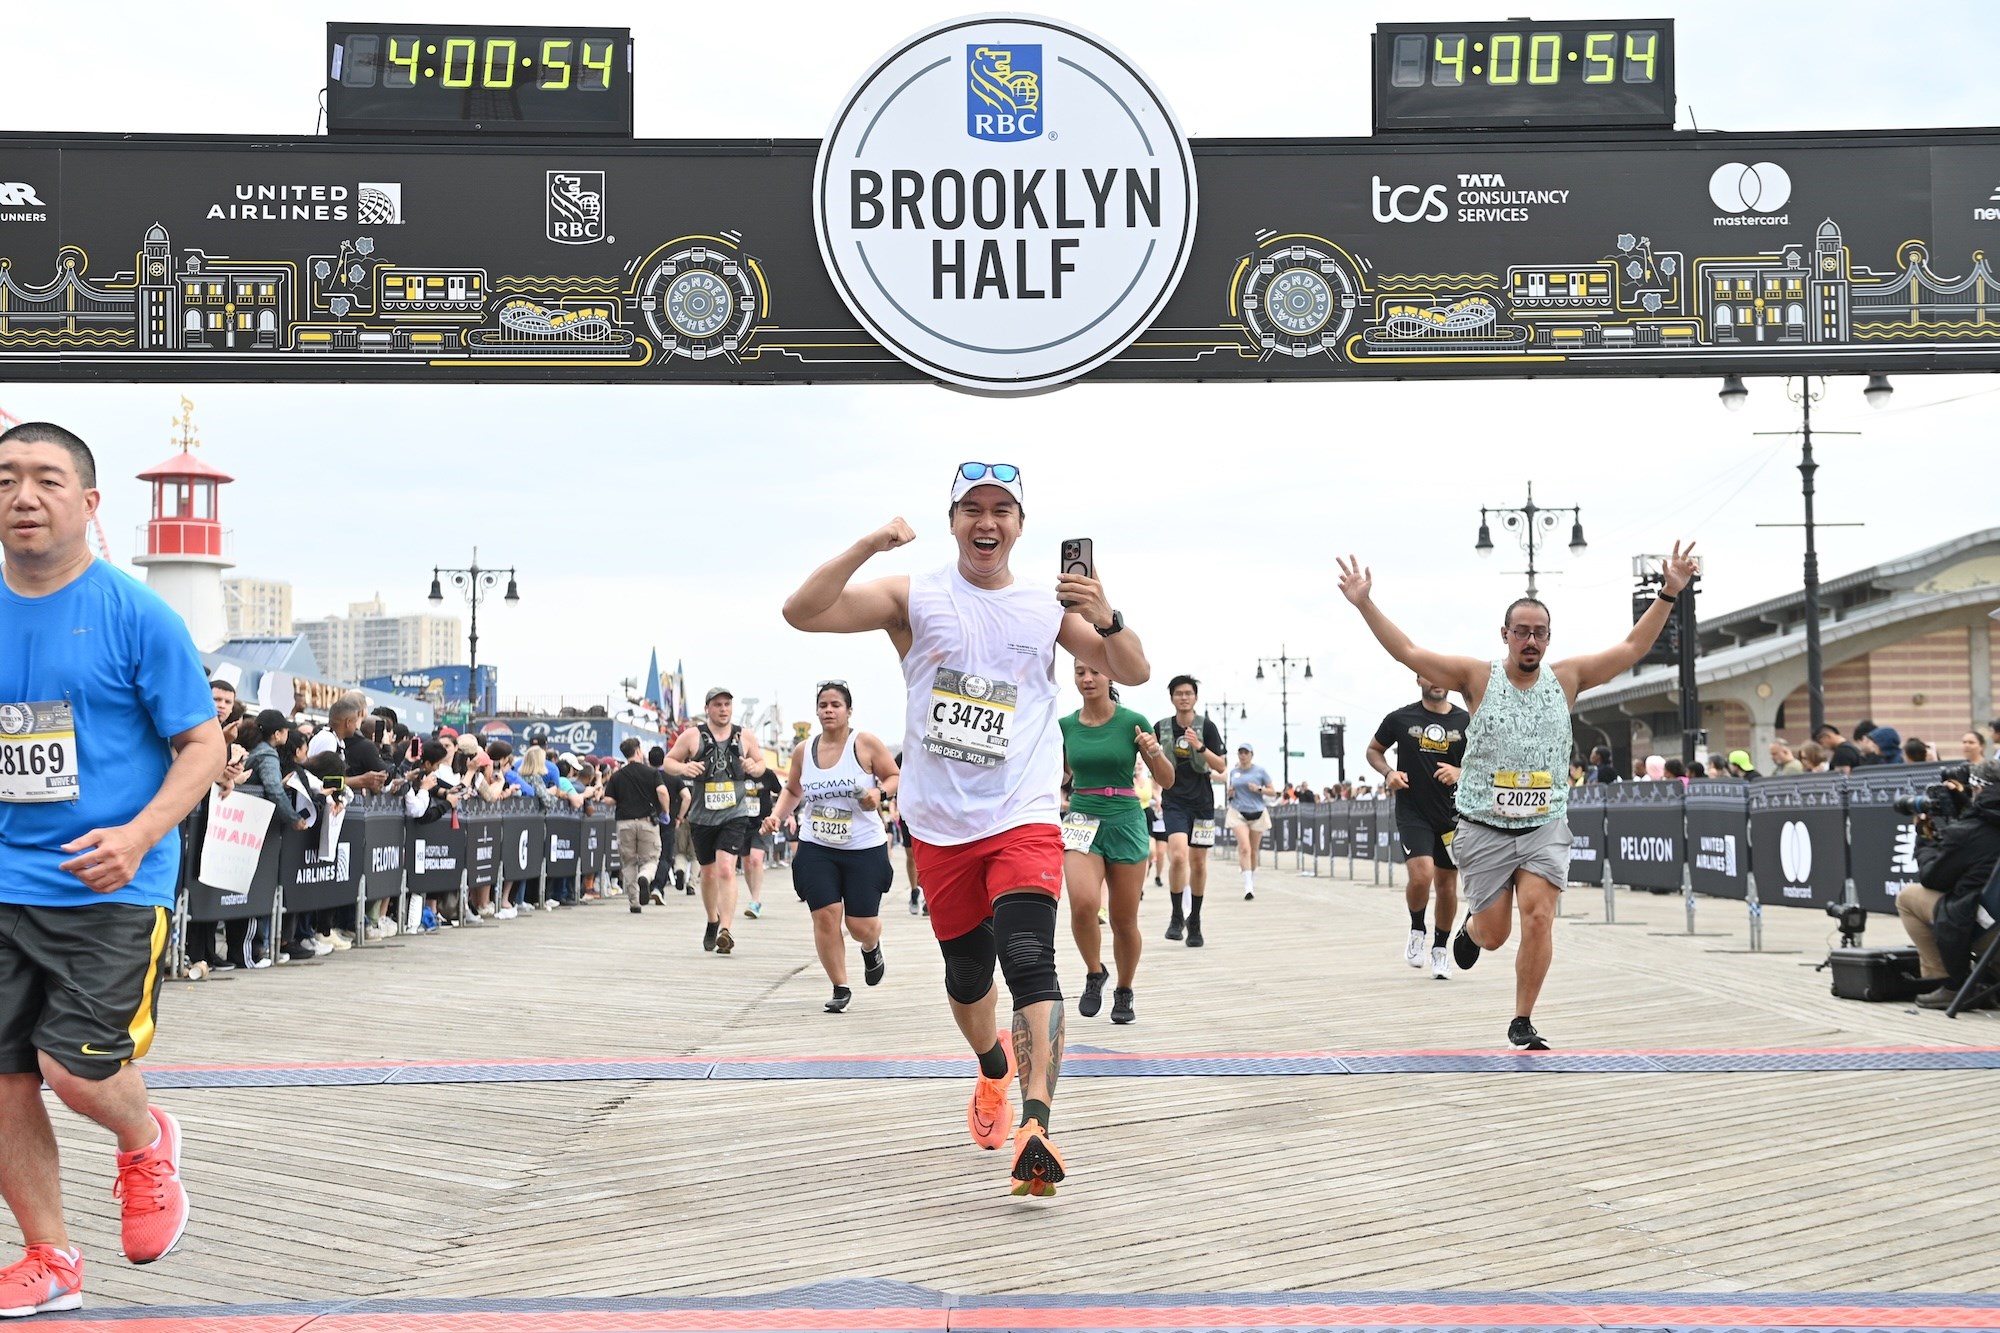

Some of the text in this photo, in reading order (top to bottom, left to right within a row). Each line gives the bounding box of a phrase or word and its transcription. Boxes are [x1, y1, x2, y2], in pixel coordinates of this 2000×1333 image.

[974, 113, 1036, 135] RBC
[1457, 174, 1506, 188] TATA
[236, 184, 348, 200] UNITED
[850, 167, 1161, 231] BROOKLYN
[1372, 175, 1448, 224] tcs
[1457, 190, 1570, 205] CONSULTANCY
[0, 213, 46, 222] UNNERS
[206, 204, 348, 220] AIRLINES
[1457, 208, 1528, 222] SERVICES
[1713, 214, 1788, 226] mastercard
[554, 222, 598, 237] RBC
[932, 238, 1080, 300] HALF
[672, 276, 726, 306] WONDER
[1272, 275, 1326, 303] WONDER
[676, 310, 724, 332] WHEEL
[1276, 308, 1324, 329] WHEEL
[933, 702, 1005, 736] C 34734
[0, 742, 64, 776] 8169
[929, 744, 986, 764] BAG CHECK 34734
[71, 776, 76, 785] 4
[1497, 792, 1546, 806] C 20228
[812, 821, 847, 834] C 33218
[1620, 836, 1673, 862] PELOTON
[1700, 836, 1724, 853] UNITED
[372, 846, 400, 872] PELOTON
[1696, 854, 1725, 872] AIRLINES
[296, 865, 335, 884] AIRLINES
